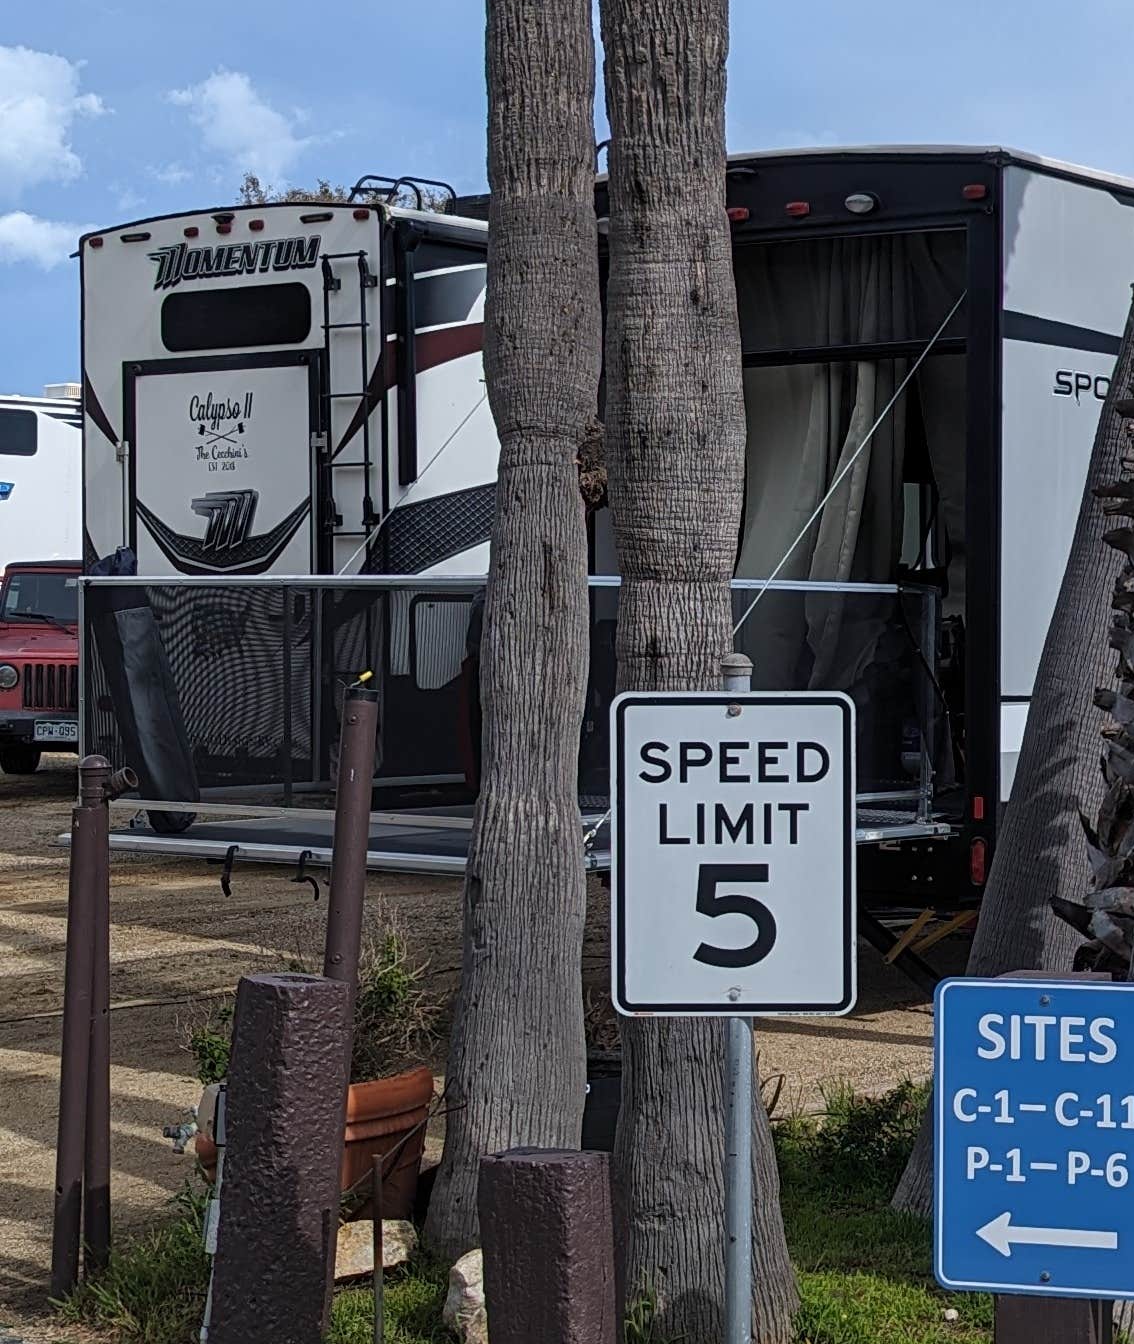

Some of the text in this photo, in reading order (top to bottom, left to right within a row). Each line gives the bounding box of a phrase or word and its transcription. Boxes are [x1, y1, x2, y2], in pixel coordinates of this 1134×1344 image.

[147, 235, 321, 290] MOMENTUM
[189, 391, 241, 431] Calypso
[195, 445, 210, 460] The
[638, 741, 831, 784] SPEED
[658, 802, 810, 845] LIMIT
[692, 863, 778, 969] 5
[977, 1013, 1118, 1064] SITES
